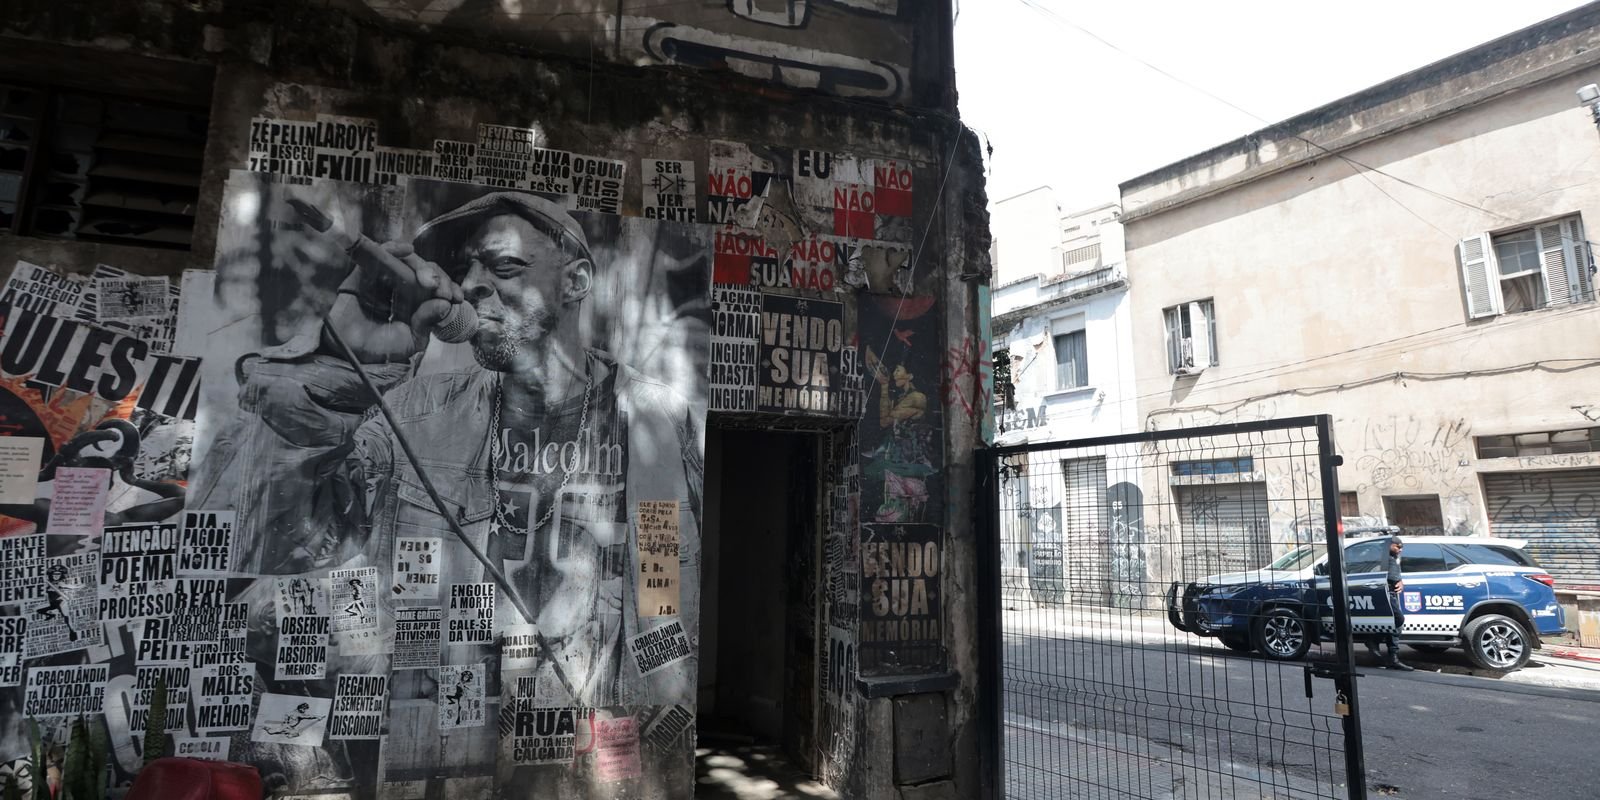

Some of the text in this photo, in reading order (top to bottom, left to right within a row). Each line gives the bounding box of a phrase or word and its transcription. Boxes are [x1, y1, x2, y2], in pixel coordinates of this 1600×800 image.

[252, 120, 316, 147] ZÉPELIN
[316, 121, 375, 152] LAROYÊ
[270, 144, 315, 161] DESCEU
[435, 141, 475, 157] SONHO
[534, 149, 570, 166] VIVA
[440, 155, 468, 168] MEU
[476, 156, 521, 170] ENQUANTO
[573, 157, 623, 180] OGUM
[656, 161, 682, 174] SER
[799, 150, 831, 179] EU
[433, 165, 473, 181] PESADELO
[532, 162, 571, 179] COMO
[875, 161, 912, 191] NÃO
[572, 175, 601, 197] YÊ!
[708, 168, 752, 199] NÃO
[657, 193, 683, 207] VER
[834, 184, 875, 213] NÃO
[791, 232, 835, 264] NÃO
[750, 262, 793, 289] SUA
[791, 262, 834, 293] NÃO
[9, 278, 28, 292] QUE
[29, 282, 80, 307] CHEGUEI
[720, 291, 760, 306] ACHAR
[710, 311, 760, 341] NORMAL
[762, 311, 843, 353] VENDO
[770, 348, 831, 388] SUA
[186, 513, 217, 529] DIA
[104, 525, 177, 556] ATENÇÃO!
[182, 528, 231, 547] PAGODE
[0, 546, 45, 562] ENTE
[180, 553, 228, 570] NOITE
[862, 541, 938, 578] VENDO
[0, 565, 46, 581] ENTE
[101, 554, 173, 585] POEMA
[0, 584, 46, 602] ENTE
[129, 583, 148, 596] EM
[175, 580, 226, 594] A VIDA
[451, 584, 494, 597] ENGOLE
[174, 592, 223, 609] REAL
[450, 597, 494, 609] A MORTE
[872, 578, 929, 617] SUA
[1425, 595, 1464, 607] IOPE
[99, 592, 174, 621] PROCESSO
[477, 609, 493, 619] NO
[171, 614, 221, 626] VIRTUAL
[282, 615, 331, 636] OBSERVE
[396, 621, 441, 632] SEU APP DE
[449, 619, 493, 632] CALE-SE
[177, 631, 220, 642] REALIDADE
[395, 630, 441, 641] ATIVISMO
[448, 630, 493, 643] DA VIDA
[634, 622, 683, 652] CRACOLÂNDIA
[862, 616, 939, 642] MEMÓRIA
[290, 634, 318, 647] MAIS
[643, 636, 677, 660] LOTADA
[192, 652, 245, 669] LIMITES
[278, 646, 326, 664] ABSORVA
[638, 640, 691, 675] SCHADENFREUDE
[36, 666, 107, 686] CRACOLÂNDIA
[218, 665, 240, 677] DOS
[285, 662, 318, 676] MENOS
[136, 666, 191, 690] REGANDO
[202, 675, 254, 696] MALES
[337, 676, 386, 697] REGANDO
[42, 683, 105, 699] LOTADA DE
[25, 696, 105, 716] SCHADENFREUDE
[222, 696, 230, 705] O
[341, 696, 374, 712] SEMENTE
[197, 703, 250, 729] MELHOR
[331, 711, 381, 734] DISCÓRDIA
[515, 710, 576, 737] RUA
[515, 739, 520, 748] E
[521, 738, 540, 748] NÃO
[556, 736, 576, 748] NEM
[513, 746, 575, 763] CALÇADA
